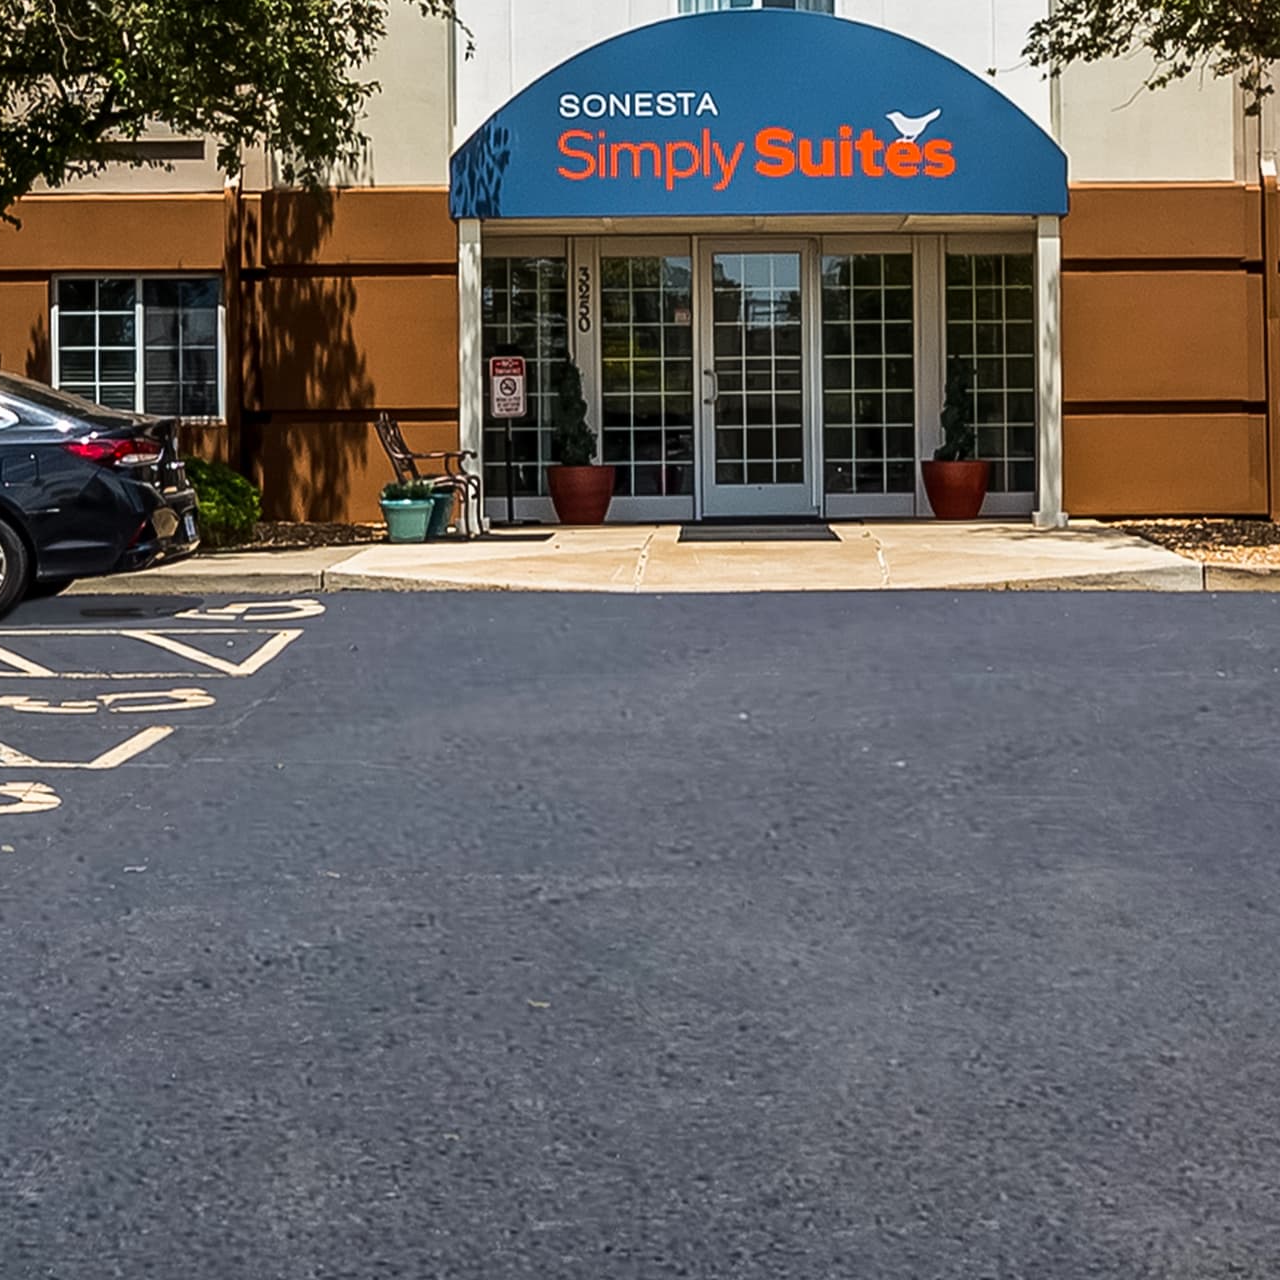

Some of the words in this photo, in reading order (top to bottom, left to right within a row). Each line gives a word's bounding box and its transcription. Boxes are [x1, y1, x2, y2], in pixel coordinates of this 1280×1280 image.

[558, 91, 719, 118] SONESTA
[557, 128, 745, 191] Simply
[754, 125, 957, 178] Suites
[578, 266, 591, 332] 3250
